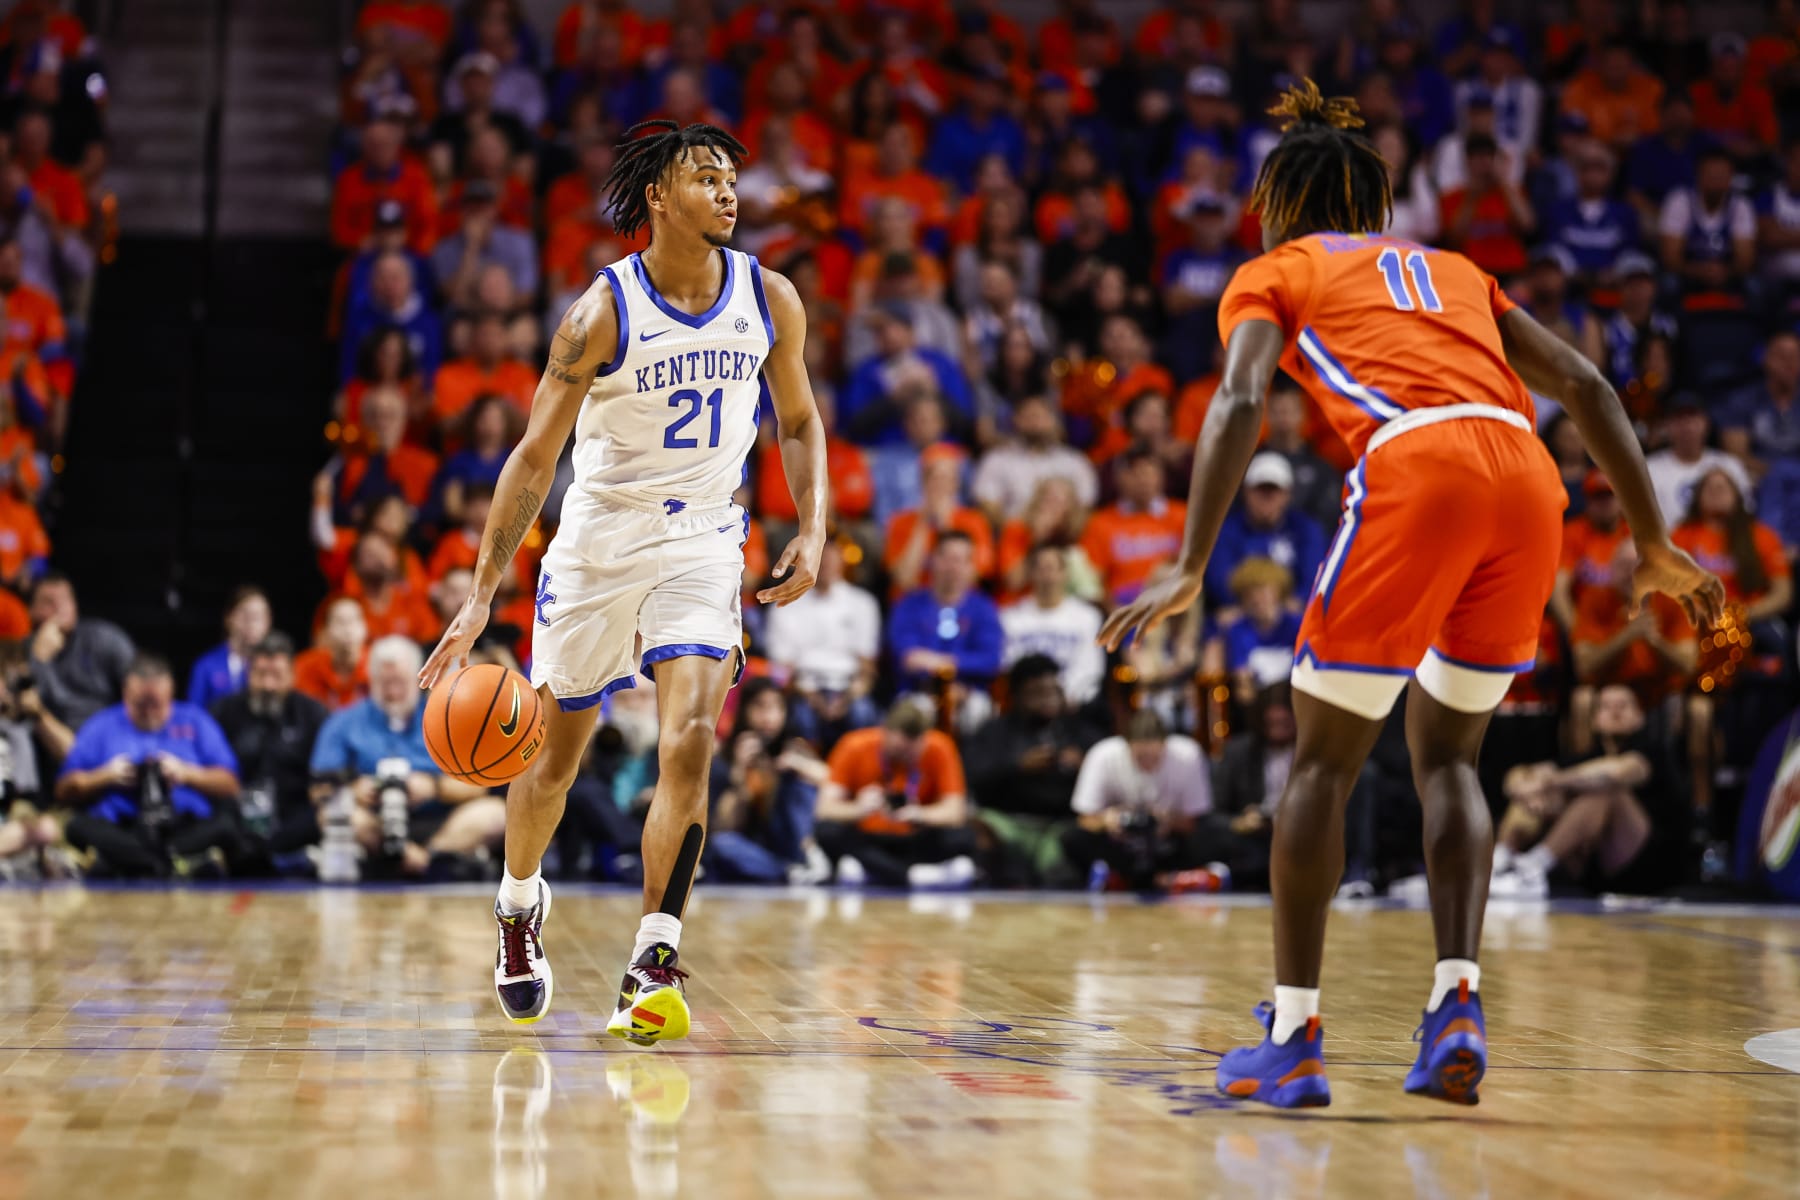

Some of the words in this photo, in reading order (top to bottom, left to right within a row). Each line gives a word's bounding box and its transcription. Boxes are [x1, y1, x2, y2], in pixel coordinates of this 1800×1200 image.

[1376, 247, 1443, 312] 11
[635, 350, 759, 393] KENTUCKY
[663, 387, 723, 448] 21
